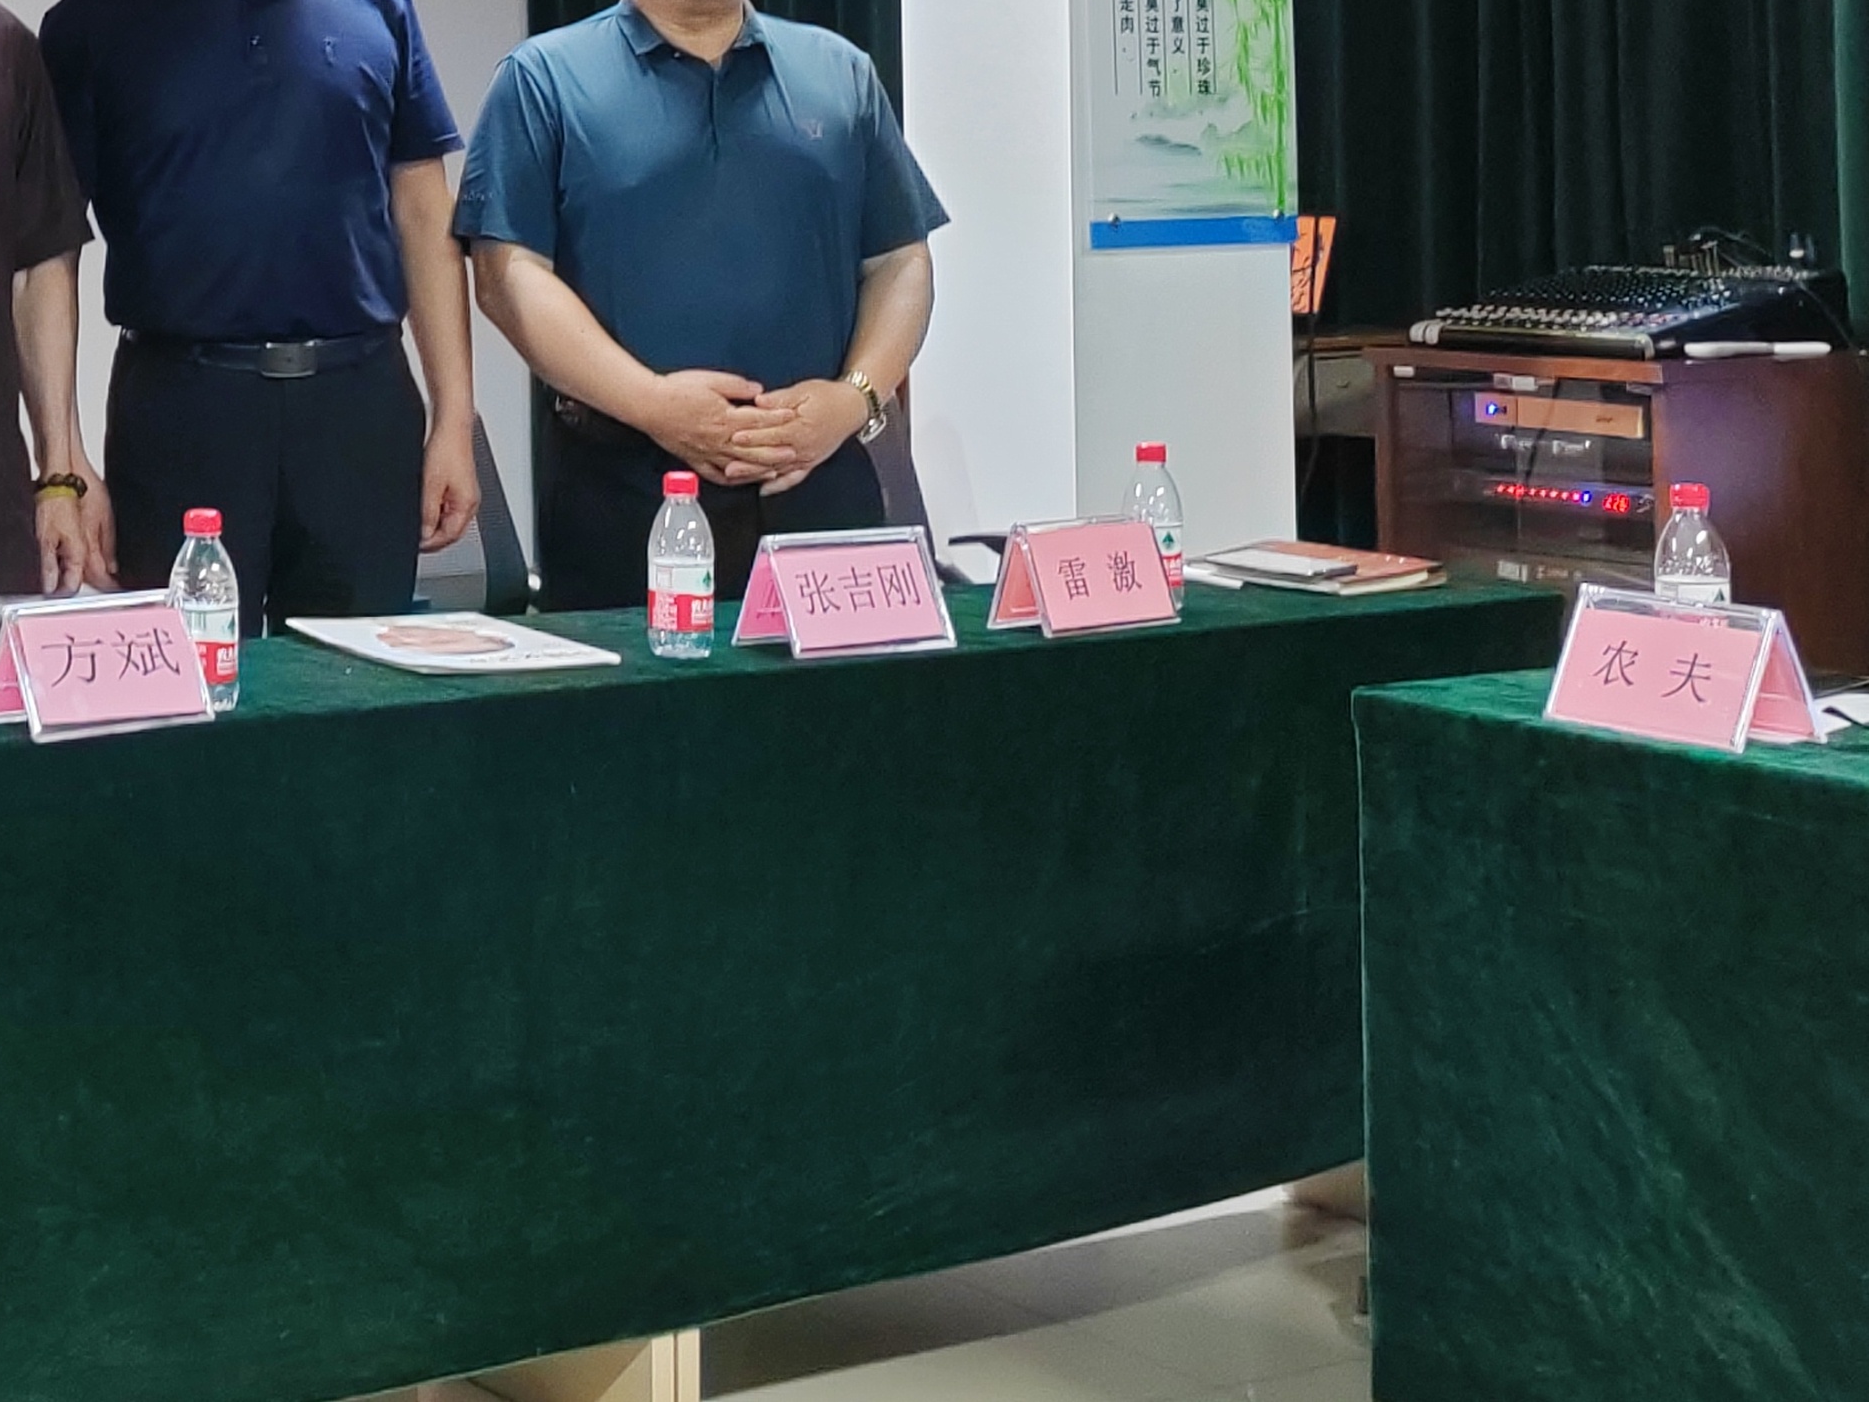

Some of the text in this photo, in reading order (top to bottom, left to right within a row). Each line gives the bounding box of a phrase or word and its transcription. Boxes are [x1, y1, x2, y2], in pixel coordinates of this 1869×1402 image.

[795, 563, 924, 617] 张吉刚
[1056, 550, 1144, 602] 雷激
[40, 628, 183, 690] 方斌
[1592, 639, 1714, 705] 农夫
